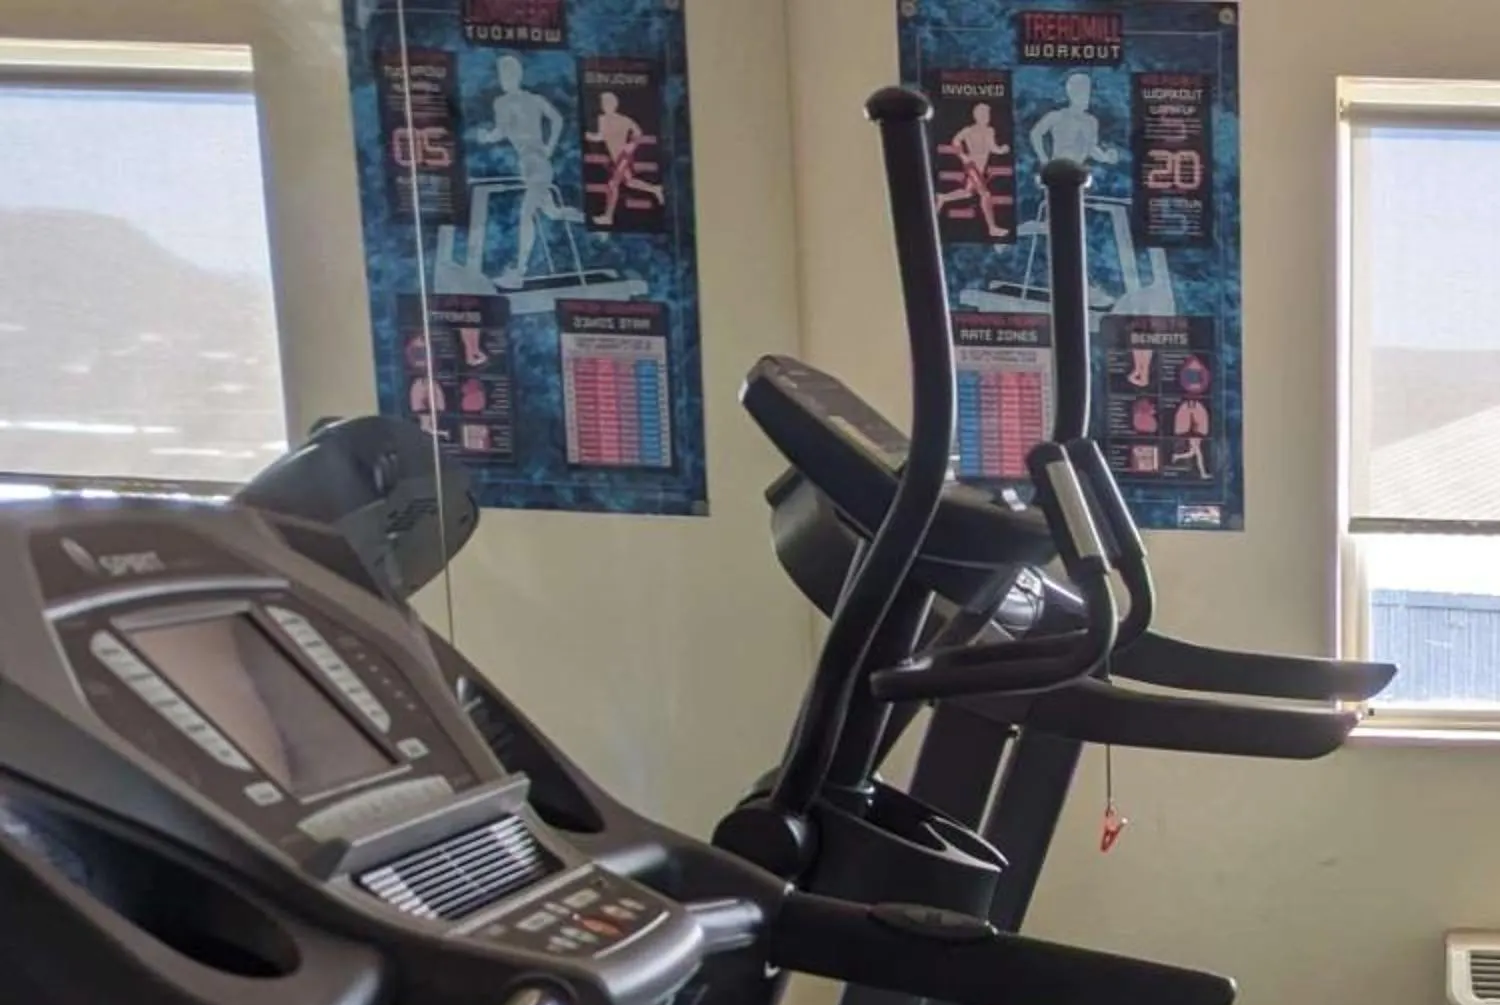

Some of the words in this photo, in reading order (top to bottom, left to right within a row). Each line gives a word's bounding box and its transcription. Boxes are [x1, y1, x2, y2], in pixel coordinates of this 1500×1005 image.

[1024, 44, 1121, 59] WORKOUT
[941, 83, 1005, 97] INVOLVED
[1143, 88, 1203, 101] WORKOUT
[1146, 149, 1201, 189] 20
[960, 329, 992, 343] RATE
[996, 330, 1038, 343] ZONES
[1131, 332, 1188, 346] BENEFITS
